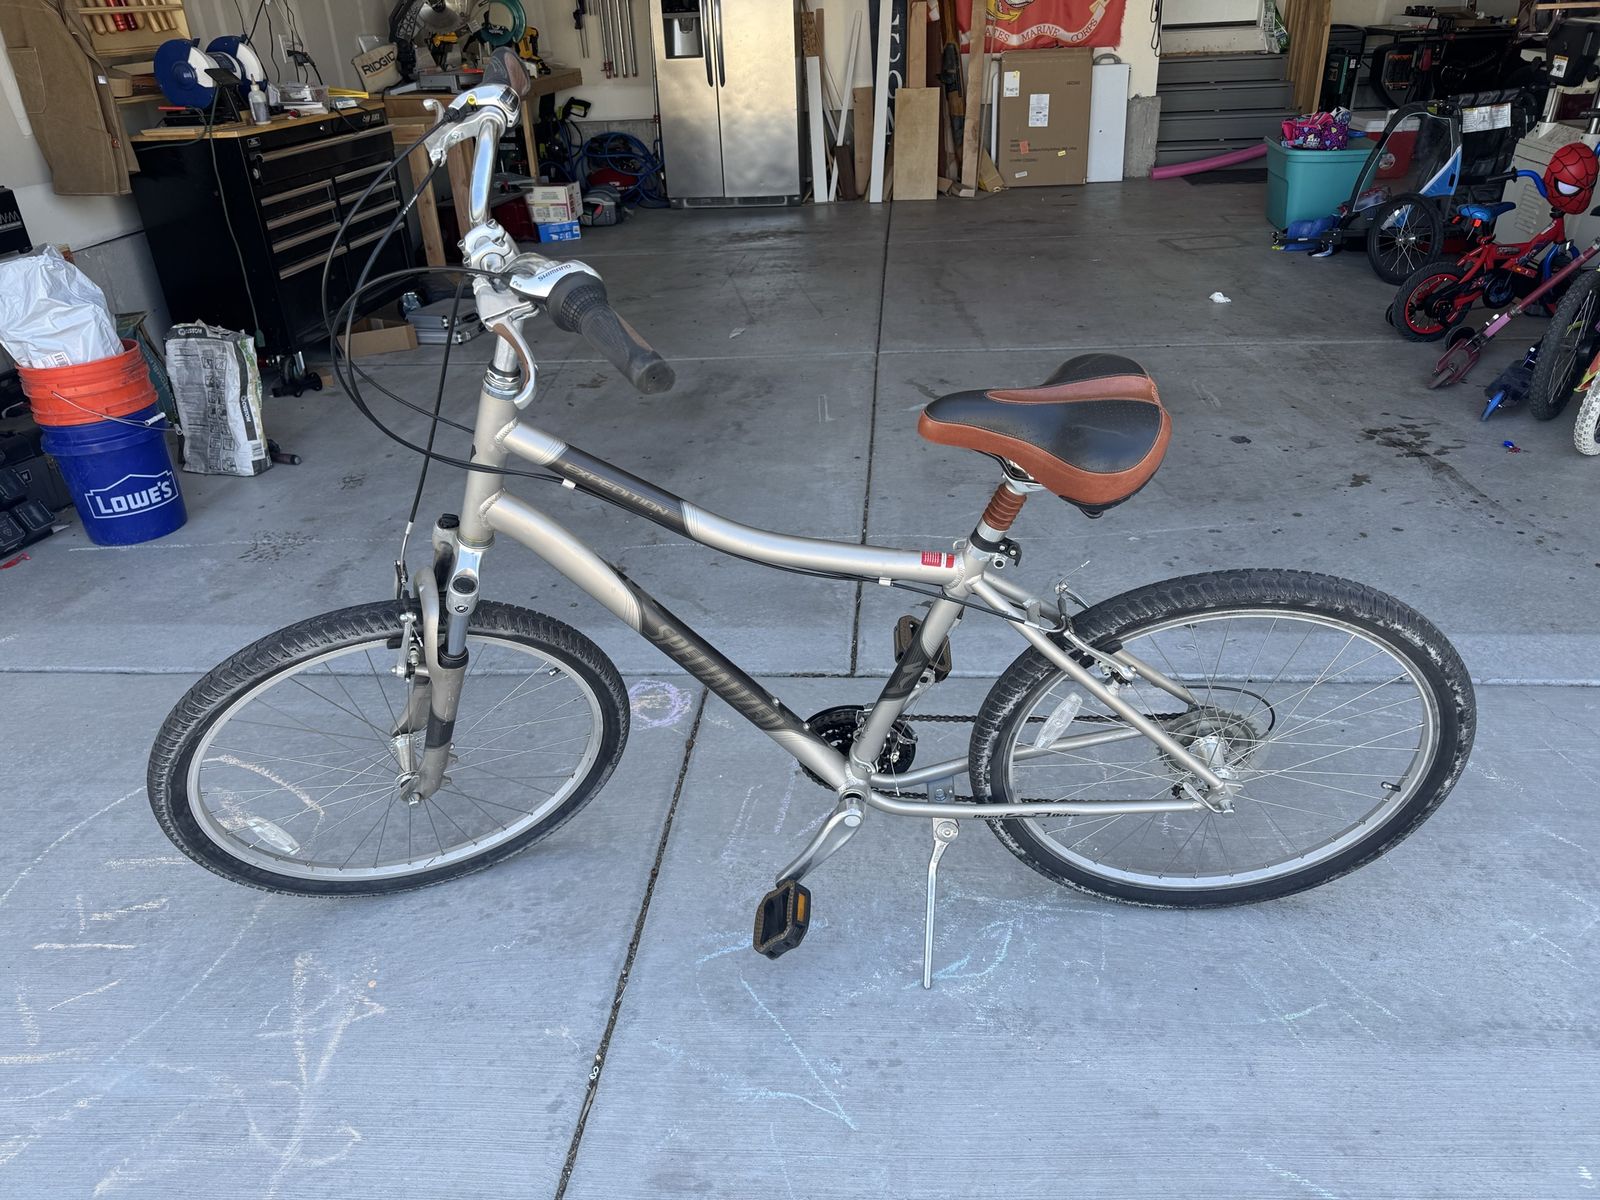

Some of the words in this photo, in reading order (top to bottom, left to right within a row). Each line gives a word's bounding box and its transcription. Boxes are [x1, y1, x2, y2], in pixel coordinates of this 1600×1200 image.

[1021, 25, 1060, 41] MARINE
[1071, 19, 1098, 43] CORPS
[361, 51, 396, 75] RIDGID
[537, 263, 572, 282] SHIMANO
[95, 481, 172, 514] LOWE'S
[563, 462, 670, 515] EXPEDITION
[648, 624, 785, 728] SPECIALIZED
